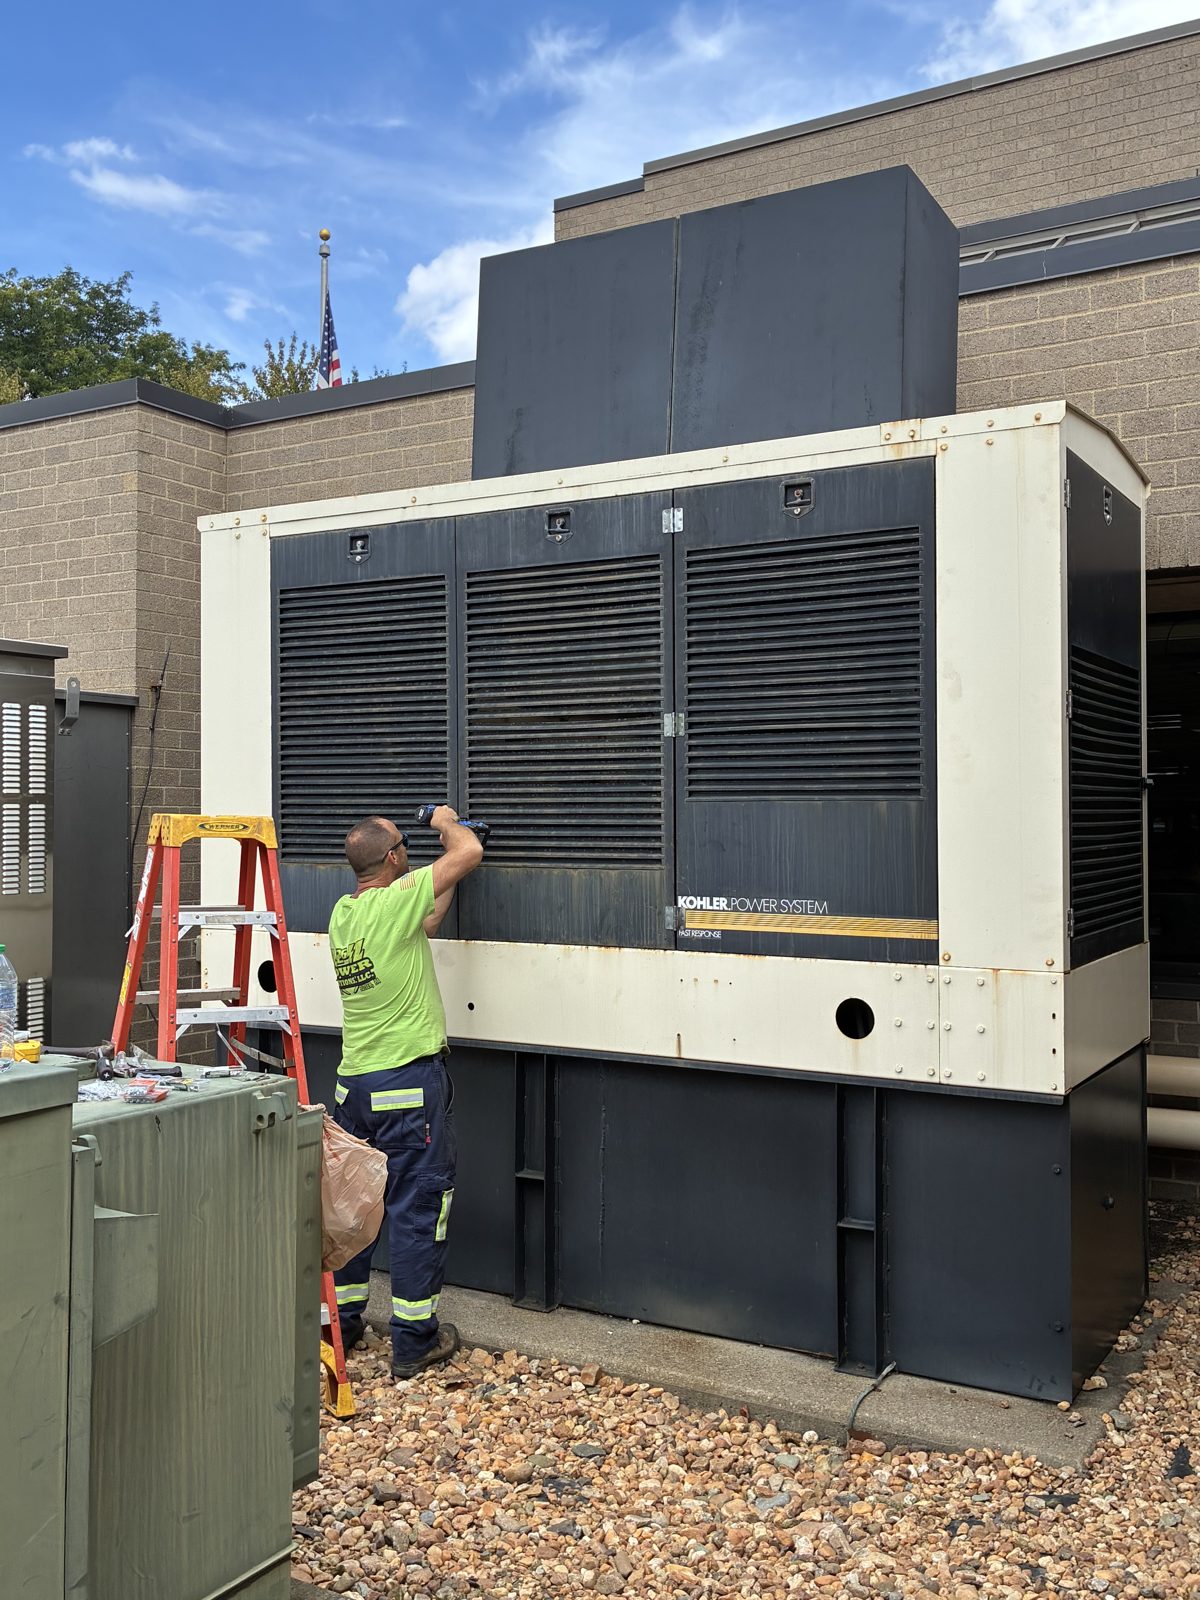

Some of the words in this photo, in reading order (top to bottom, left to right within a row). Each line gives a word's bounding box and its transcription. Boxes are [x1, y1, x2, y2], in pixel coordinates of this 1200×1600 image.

[730, 897, 777, 913] POWER
[779, 898, 828, 915] SYSTEM
[678, 929, 691, 937] FAST
[691, 930, 722, 939] RESPONSE
